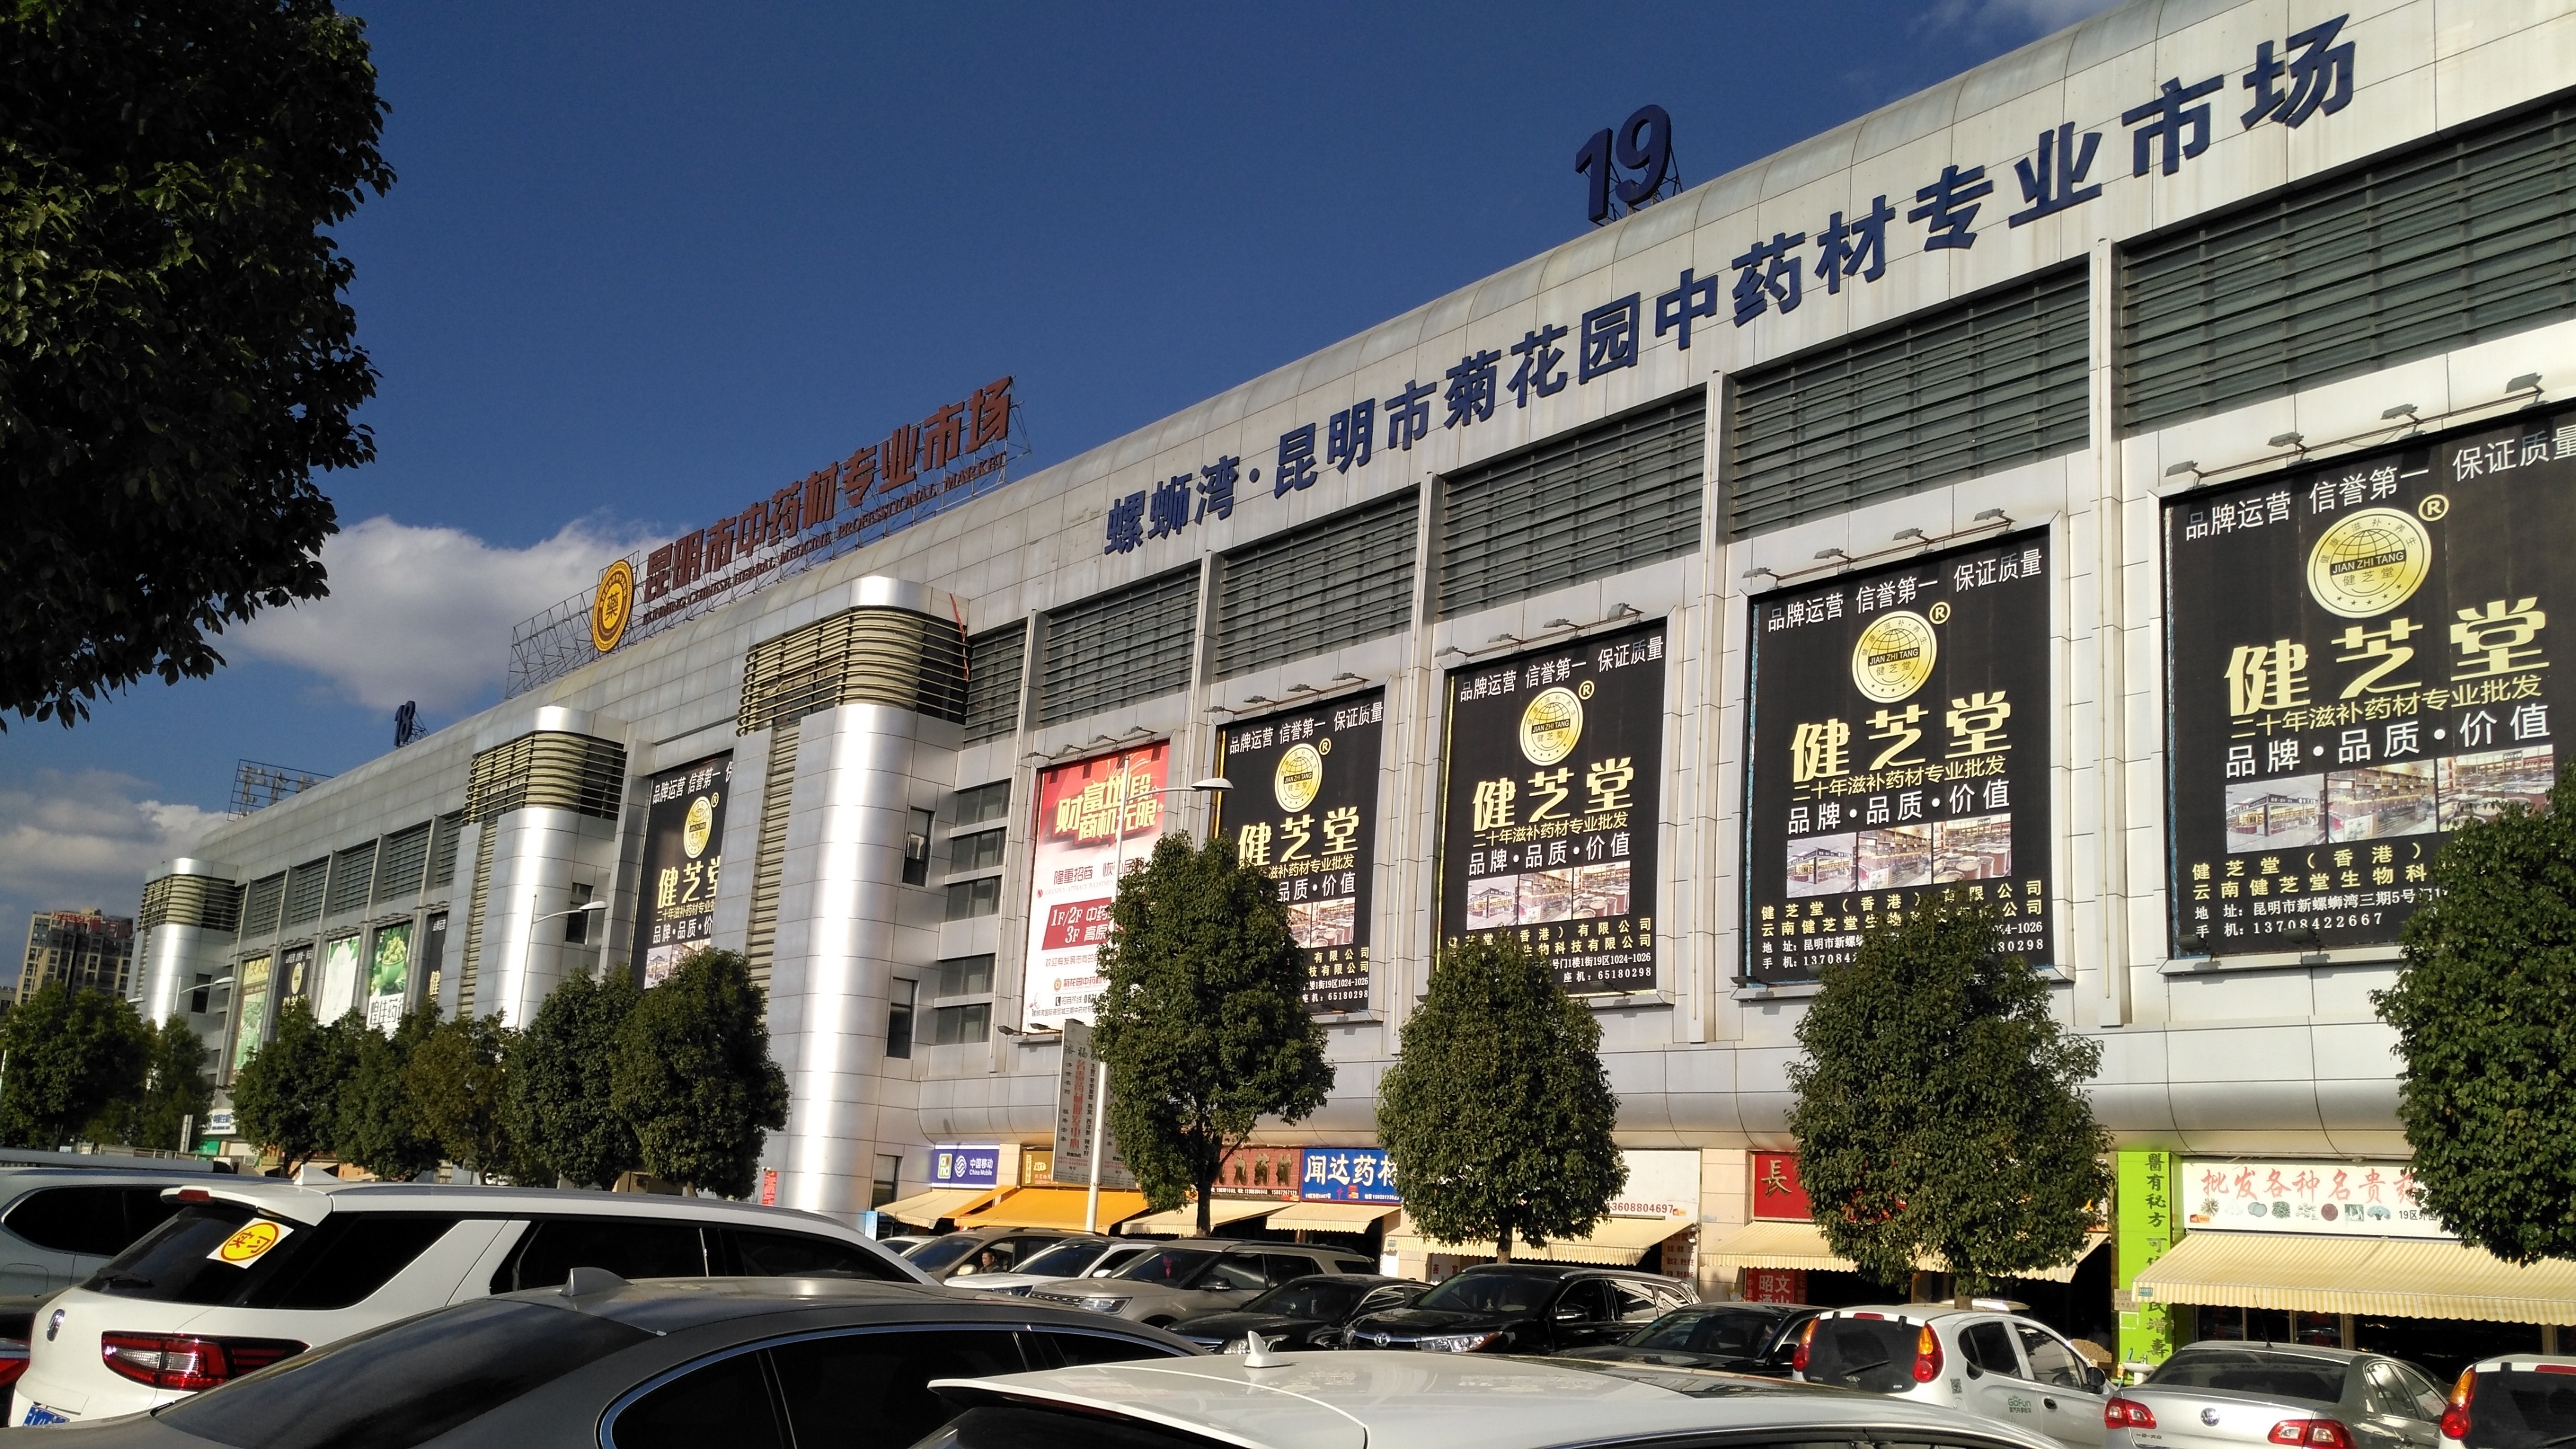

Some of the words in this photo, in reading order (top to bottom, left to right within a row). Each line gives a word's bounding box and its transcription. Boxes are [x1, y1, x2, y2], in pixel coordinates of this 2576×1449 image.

[1575, 104, 1671, 223] 19
[643, 376, 1011, 603] 昆明市中药材专业市场
[945, 452, 1005, 491] MARKET
[2185, 491, 2291, 541] 品牌运营
[2309, 465, 2430, 514] 信誉第一
[2452, 424, 2576, 482] 保证质量
[2332, 560, 2356, 575] JIAN
[2356, 556, 2376, 571] ZHI
[2376, 550, 2405, 566] TANG
[2342, 567, 2395, 587] 健芝堂
[1768, 592, 1844, 633] 品牌运营
[1856, 575, 1939, 614] 信誉第一
[1953, 548, 2043, 593] 保证质量
[1460, 670, 1517, 702] 品牌运营
[1525, 658, 1587, 689] 信誉第一
[1598, 636, 1664, 673] 保证质量
[1869, 655, 1886, 666] JIAN
[1886, 652, 1899, 662] ZHI
[1899, 648, 1919, 660] TANG
[1876, 661, 1912, 677] 健芝堂
[2223, 597, 2550, 717] 健芝堂
[394, 701, 415, 746] 18
[2231, 673, 2543, 739] 二十年滋补药材专业批发
[1229, 726, 1273, 755] 品牌运营
[1279, 717, 1326, 745] 信誉第一
[1334, 701, 1384, 733] 保证质量
[1532, 724, 1544, 733] JIAN
[1545, 723, 1554, 731] ZHI
[1554, 719, 1570, 729] TANG
[1537, 730, 1564, 743] 健芝堂
[1790, 690, 2012, 783] 健芝堂
[653, 776, 686, 804] 品牌运营
[687, 767, 721, 796] 信誉第一
[1301, 772, 1312, 781] TANG
[1472, 757, 1634, 832] 健芝堂
[1793, 755, 2006, 801] 二十年滋补药材专业批发
[1238, 806, 1359, 869] 健芝堂
[1473, 811, 1629, 848] 二十年滋补药材专业批发
[1054, 865, 1093, 885] 隆重招商
[1051, 906, 1083, 927] 1F/2F
[1065, 925, 1080, 944] 3F
[1314, 947, 1369, 964] 有限公司
[969, 1158, 994, 1169] 中国移动
[1761, 1159, 1793, 1198] 長
[1607, 1202, 1673, 1214] 13608804697
[227, 1231, 272, 1254] 实习
